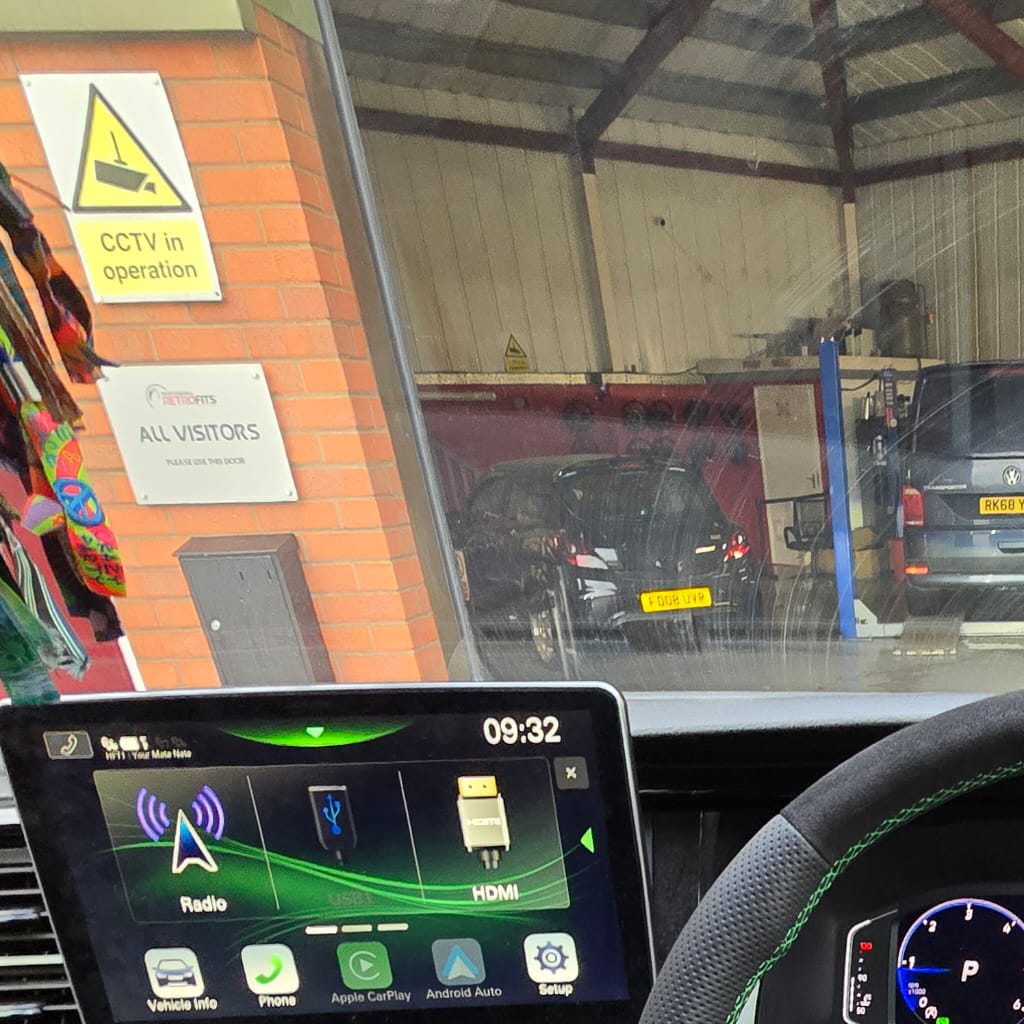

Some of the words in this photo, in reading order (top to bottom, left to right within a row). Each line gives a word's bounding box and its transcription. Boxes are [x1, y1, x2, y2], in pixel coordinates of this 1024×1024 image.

[100, 232, 156, 252] CCTV
[164, 232, 184, 251] in
[103, 260, 198, 284] operation
[139, 425, 171, 443] ALL
[172, 423, 260, 442] VISITORS
[224, 456, 246, 465] DOOR
[483, 716, 562, 745] 09:32
[471, 883, 520, 902] HDMI
[179, 894, 228, 914] Radio
[927, 919, 938, 933] 2
[1001, 921, 1012, 935] 4
[908, 955, 916, 970] 1
[960, 960, 980, 983] P
[330, 991, 366, 1006] Apple
[366, 989, 411, 1004] CarPlay
[425, 987, 472, 1000] Android
[474, 986, 503, 999] Auto
[538, 982, 574, 997] Setup
[146, 998, 192, 1013] Vehicle
[193, 996, 218, 1011] Info
[257, 994, 297, 1008] Phone
[918, 996, 929, 1009] 0
[1012, 998, 1022, 1011] 6
